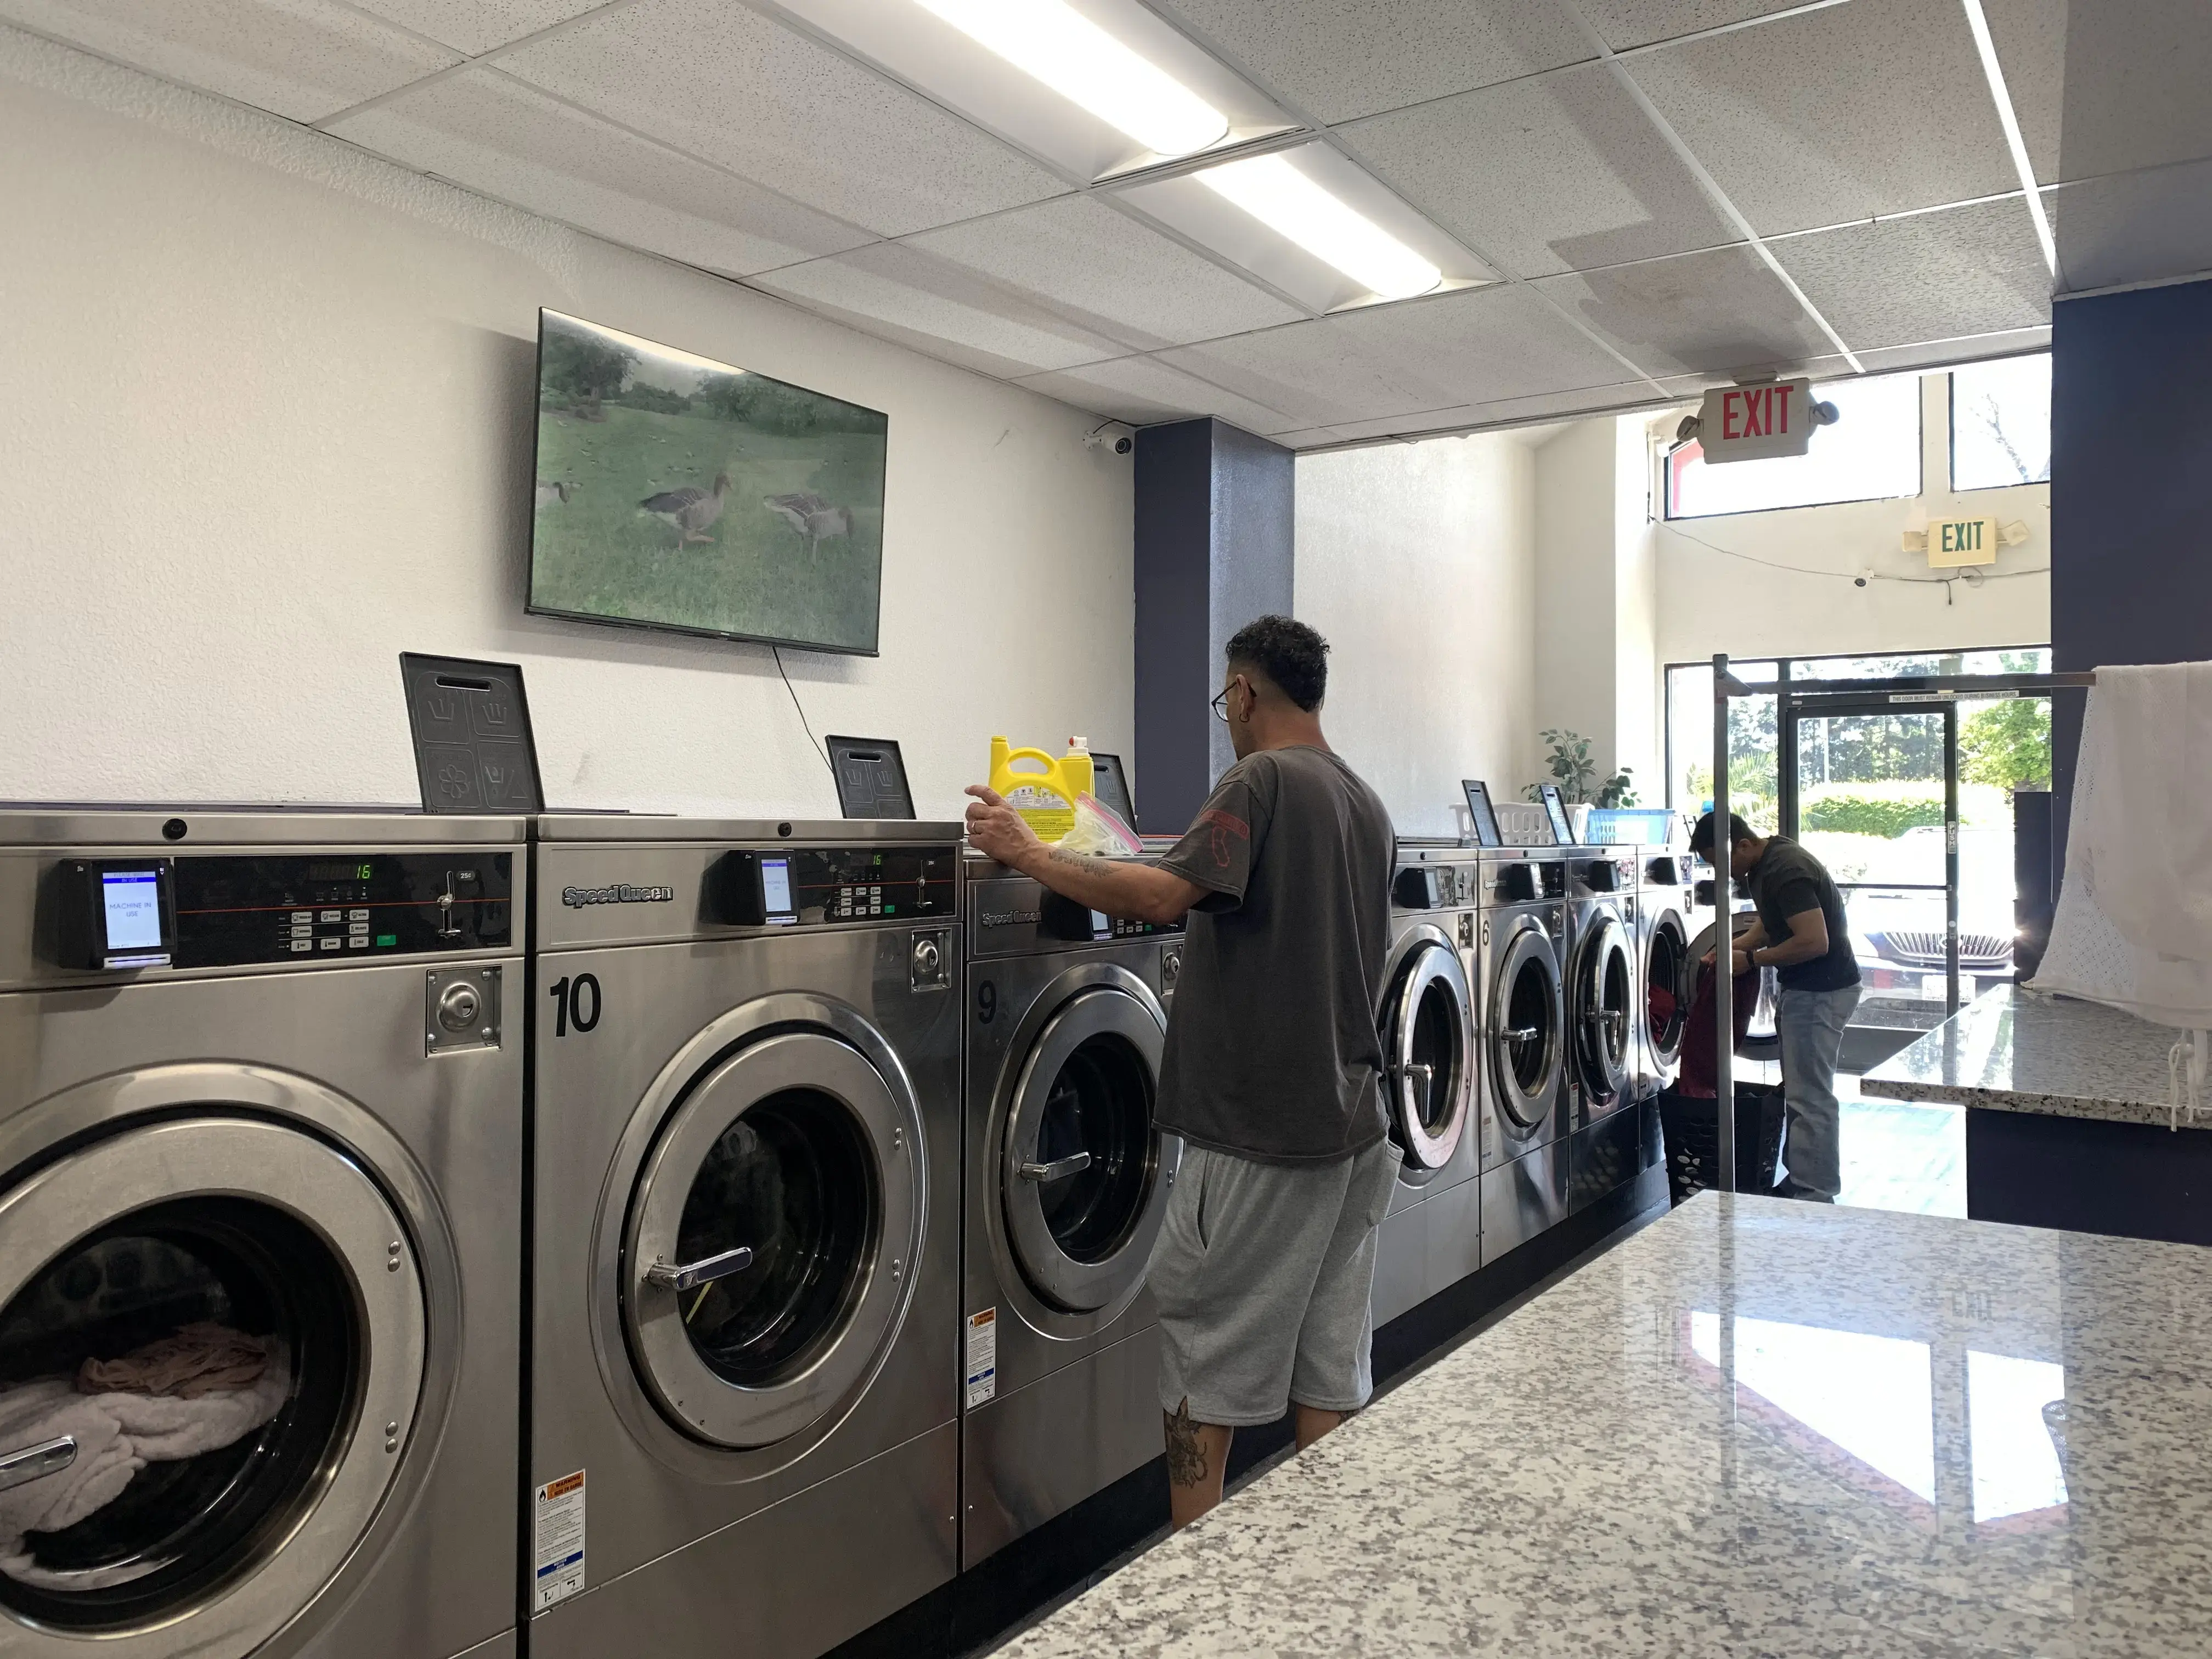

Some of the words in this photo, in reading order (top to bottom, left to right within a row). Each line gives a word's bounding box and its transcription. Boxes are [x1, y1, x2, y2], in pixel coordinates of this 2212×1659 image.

[1723, 386, 1794, 440] EXIT
[1942, 521, 1984, 552] EXIT
[357, 865, 371, 879] 16
[873, 855, 882, 865] 16
[1482, 920, 1490, 946] 6
[550, 973, 601, 1037] 10
[978, 980, 997, 1024] 9
[556, 1475, 580, 1488] WARNING
